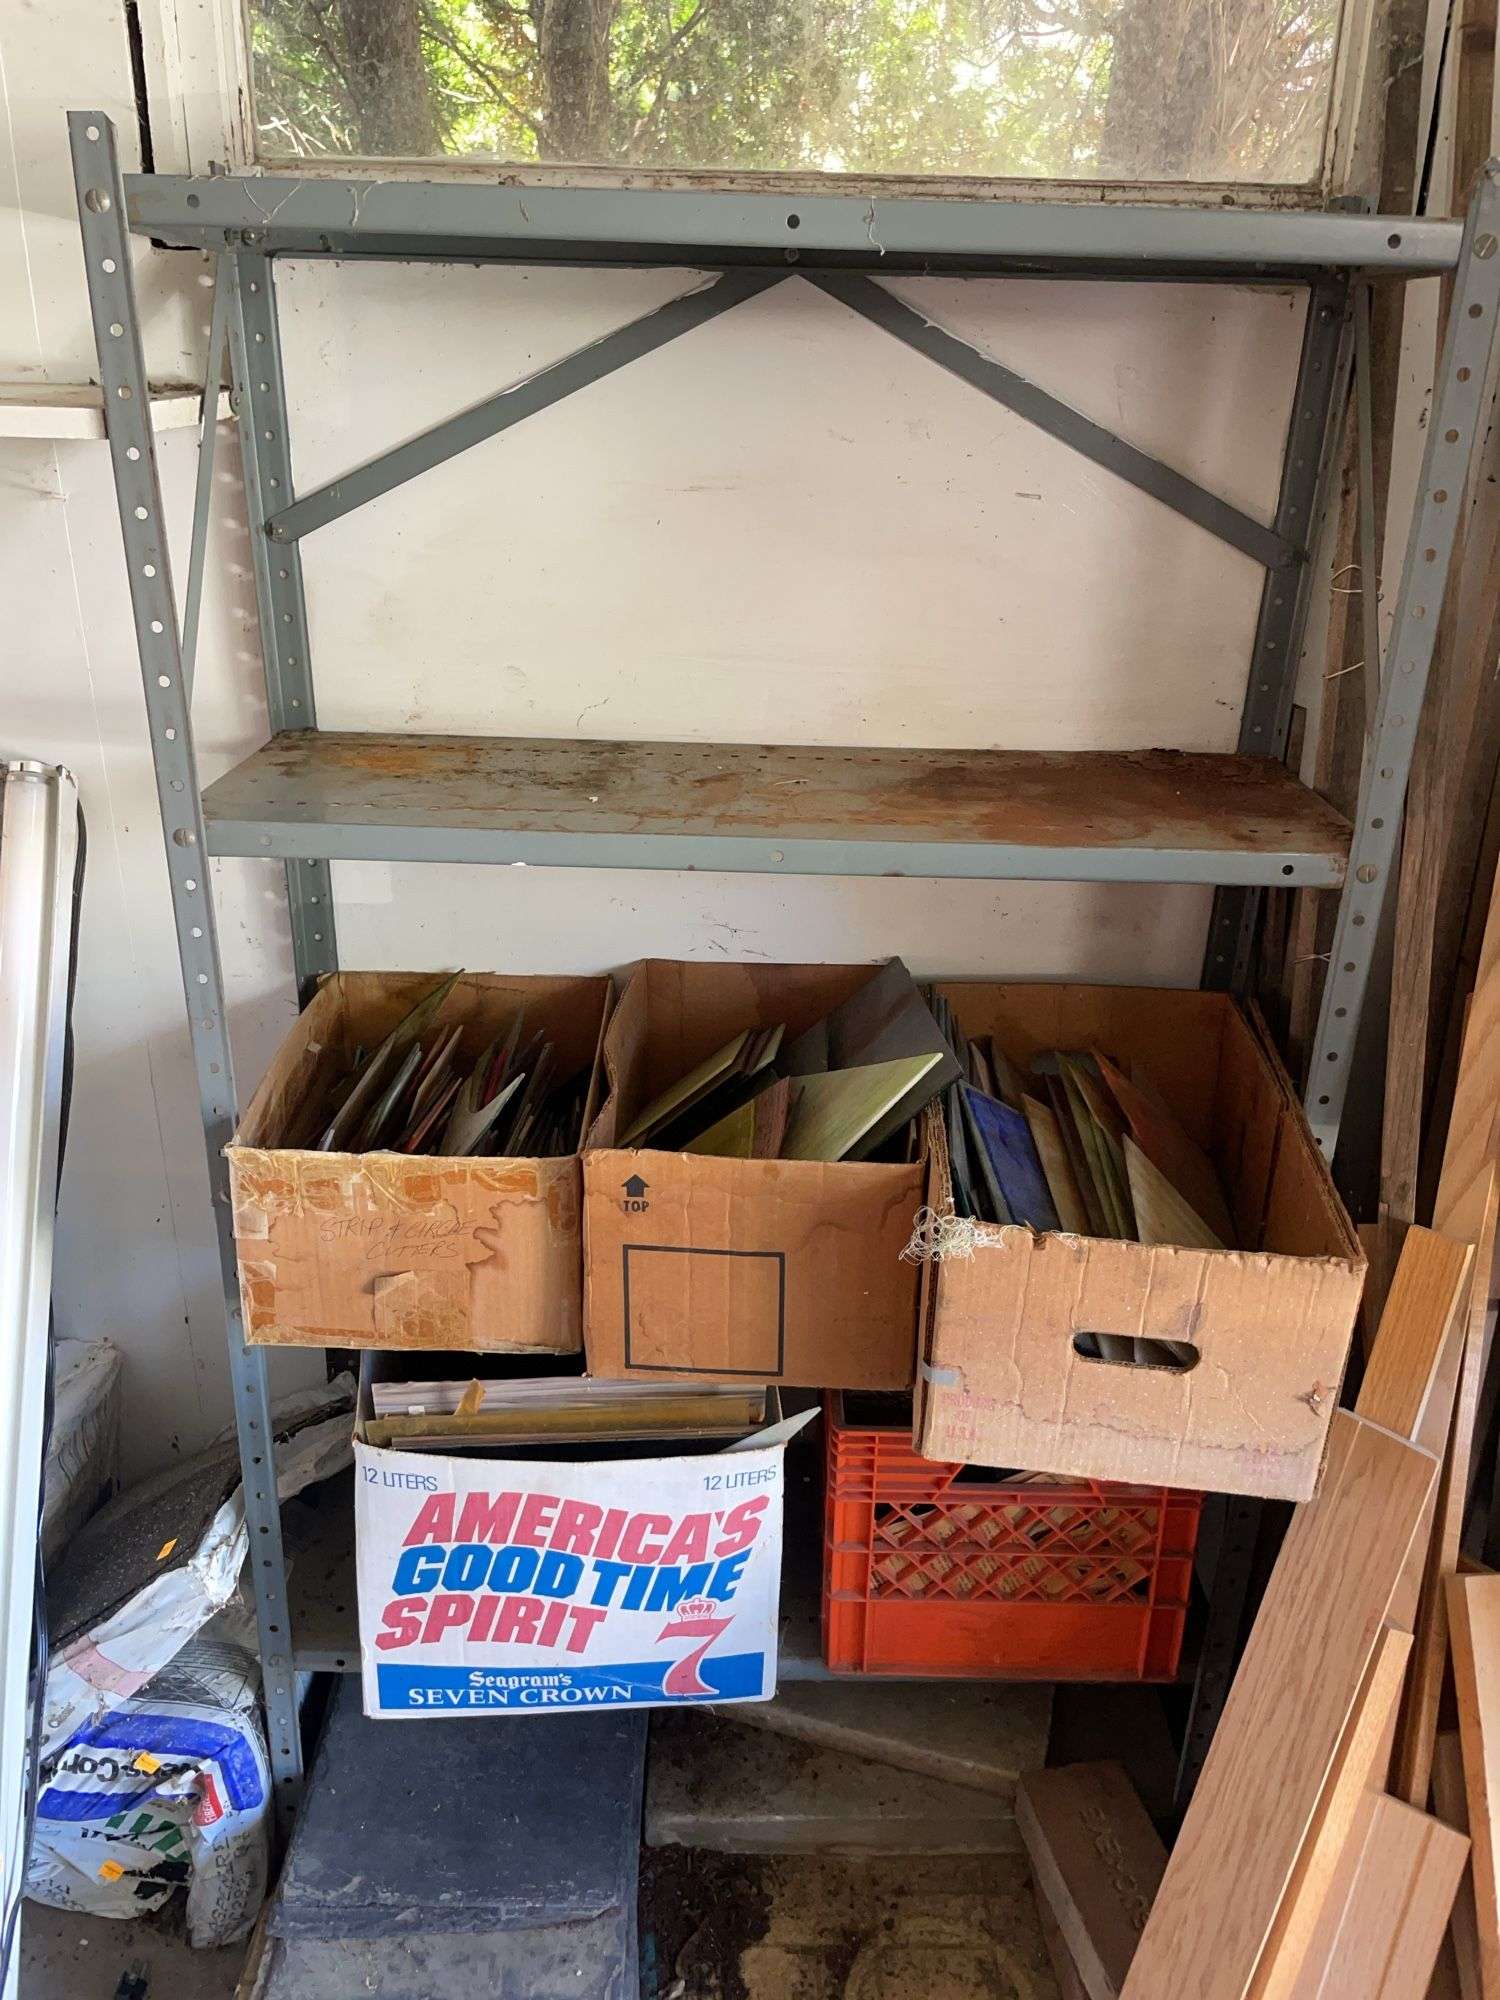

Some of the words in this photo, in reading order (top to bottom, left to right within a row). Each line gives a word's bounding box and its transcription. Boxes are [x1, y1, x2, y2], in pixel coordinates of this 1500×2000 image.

[623, 1200, 650, 1213] TOP
[362, 1466, 379, 1484] 12
[383, 1471, 439, 1491] LITERS
[703, 1475, 722, 1491] 12
[725, 1464, 777, 1489] LITERS
[402, 1491, 771, 1566] AMERICA'S
[391, 1544, 586, 1599] GOOD
[591, 1547, 753, 1612] TIME
[374, 1594, 608, 1654] SPIRIT
[654, 1614, 737, 1697] 7
[468, 1670, 572, 1689] Seagram's
[408, 1688, 509, 1706] SEVEN
[519, 1685, 633, 1702] CROWN
